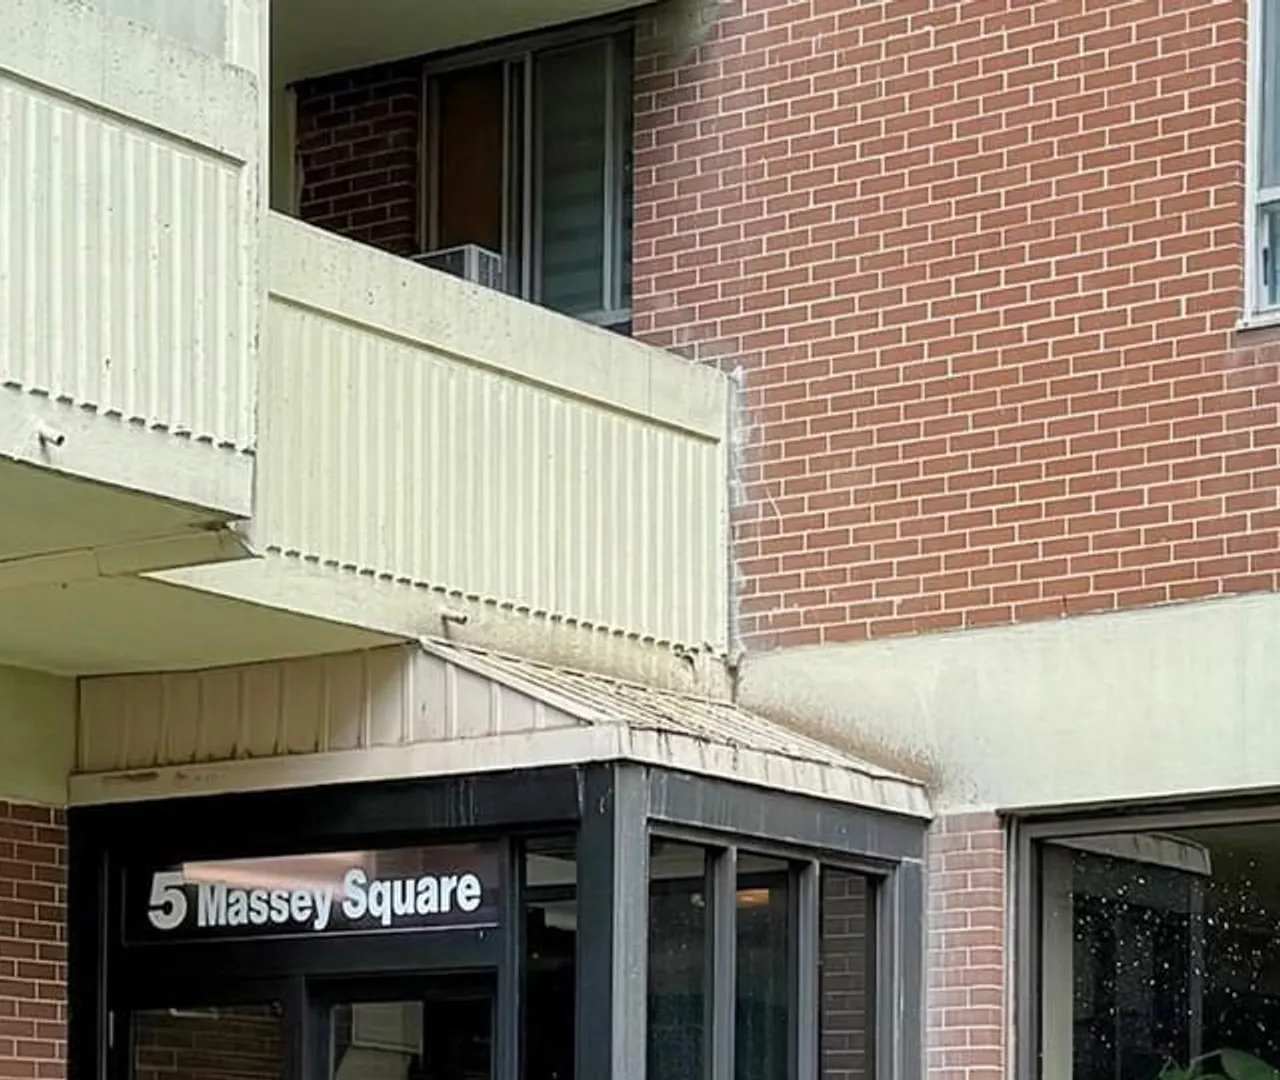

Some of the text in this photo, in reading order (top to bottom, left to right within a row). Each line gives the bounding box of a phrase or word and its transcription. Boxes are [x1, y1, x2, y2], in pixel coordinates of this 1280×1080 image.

[148, 868, 482, 930] 5 Massey Square
